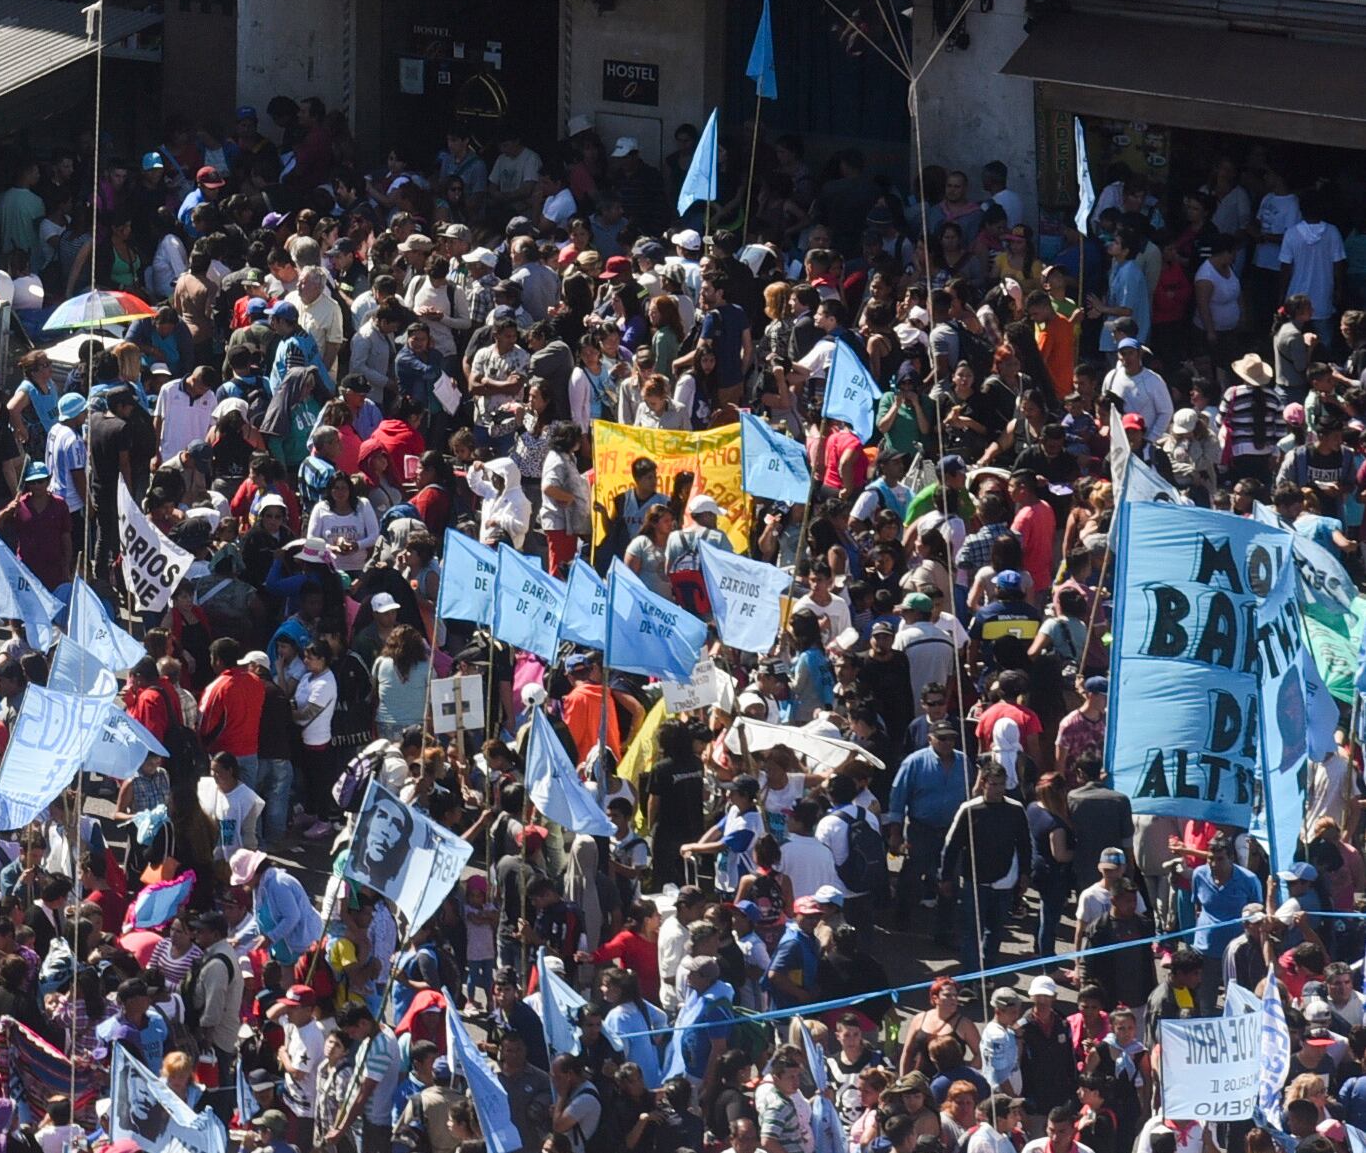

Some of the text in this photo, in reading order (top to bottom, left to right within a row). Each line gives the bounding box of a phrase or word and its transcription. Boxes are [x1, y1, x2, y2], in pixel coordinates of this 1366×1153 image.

[606, 63, 657, 82] HOSTEL
[844, 387, 857, 401] DE
[767, 460, 780, 472] DE
[474, 577, 487, 592] DE
[719, 576, 761, 598] BARRIOS
[516, 598, 529, 615] DE
[591, 601, 604, 616] DE
[740, 602, 757, 618] PIE
